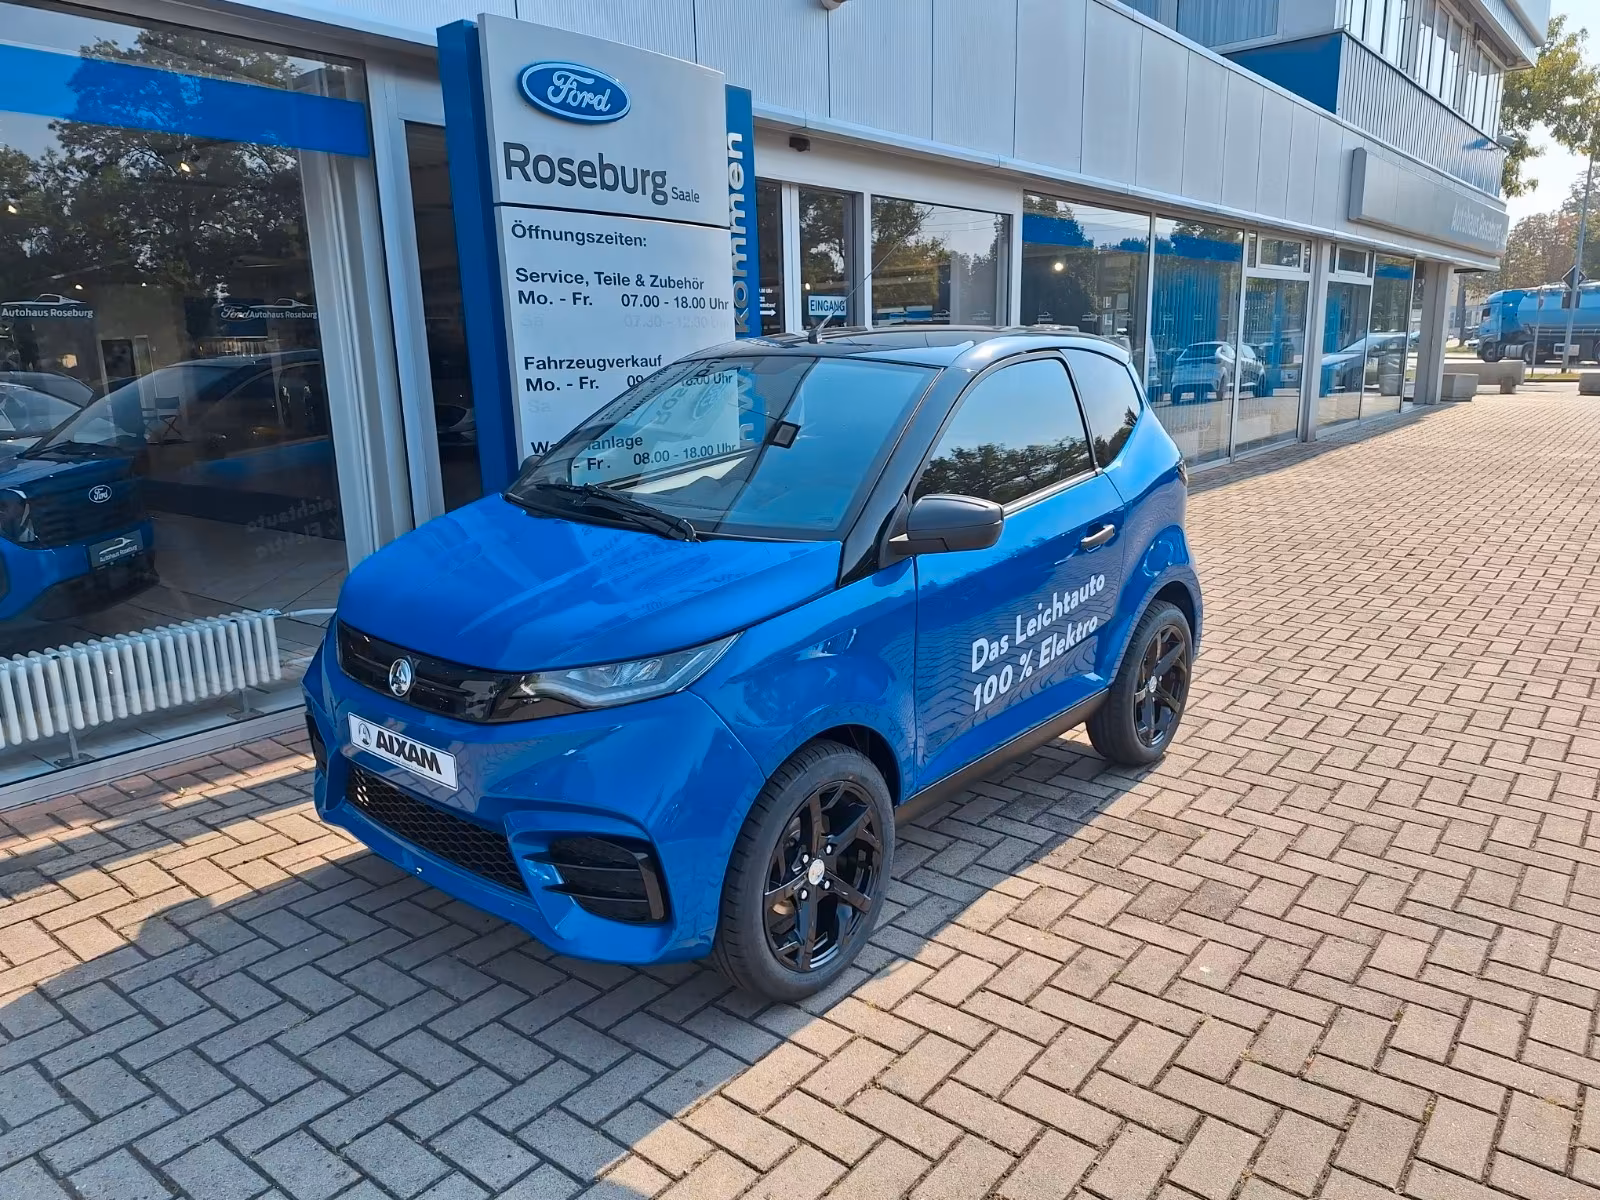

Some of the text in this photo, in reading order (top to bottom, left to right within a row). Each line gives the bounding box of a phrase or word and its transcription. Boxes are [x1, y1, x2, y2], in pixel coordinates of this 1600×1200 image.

[547, 70, 611, 112] Ford
[503, 142, 700, 205] Roseburg Saale
[511, 220, 647, 247] Öffnungszeiten:
[515, 267, 704, 290] Service, Teile & Zubehör
[518, 290, 554, 305] Mo.
[572, 292, 593, 306] Fr.
[621, 293, 660, 308] 07.00
[674, 297, 706, 310] 18.00
[709, 297, 730, 310] Uhr
[810, 299, 846, 312] EINGANG
[1, 308, 94, 319] Autohaus Roseburg
[250, 310, 284, 319] Autohaus
[285, 310, 318, 320] Roseburg
[524, 354, 663, 373] Fahrzeugverkauf
[526, 378, 561, 392] Mo.
[579, 376, 600, 390] Fr.
[714, 372, 733, 384] Uhr
[633, 451, 670, 466] 08.00
[684, 446, 714, 459] 18.00
[717, 442, 737, 454] Uhr
[971, 574, 1106, 673] Das Leichtauto
[973, 615, 1098, 712] 100 % Elektro
[376, 730, 443, 775] AIXAM
